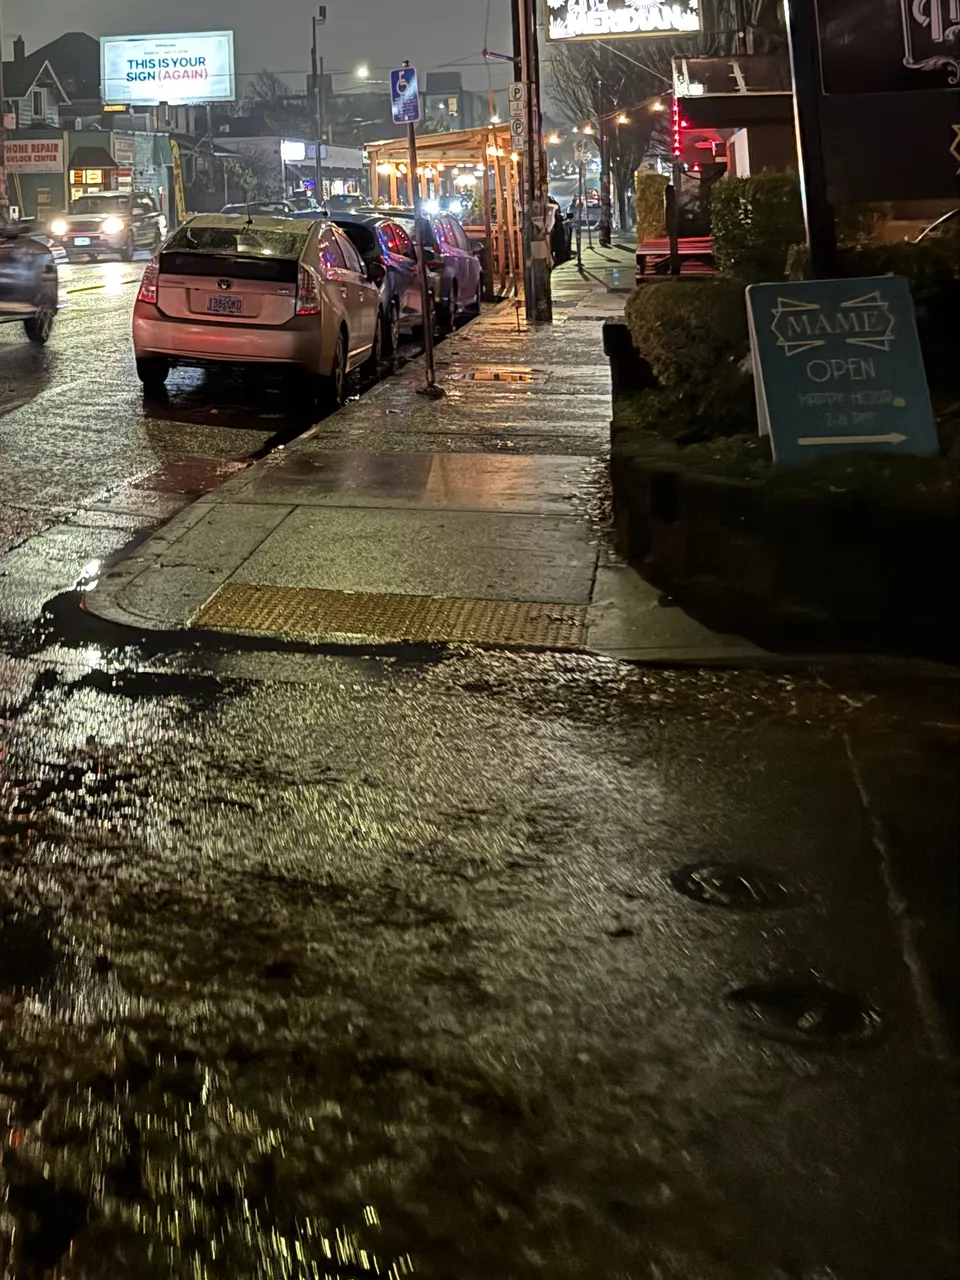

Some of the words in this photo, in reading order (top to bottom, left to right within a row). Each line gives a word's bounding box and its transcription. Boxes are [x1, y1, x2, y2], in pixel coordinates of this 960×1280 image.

[566, 5, 682, 34] MERIDIAN
[127, 59, 156, 69] THIS
[158, 58, 169, 68] IS
[169, 57, 206, 68] YOUR
[126, 72, 156, 82] SIGN
[158, 69, 208, 81] (AGAIN)
[31, 143, 59, 153] REPAIR
[787, 311, 883, 336] MAME
[806, 357, 876, 382] OPEN
